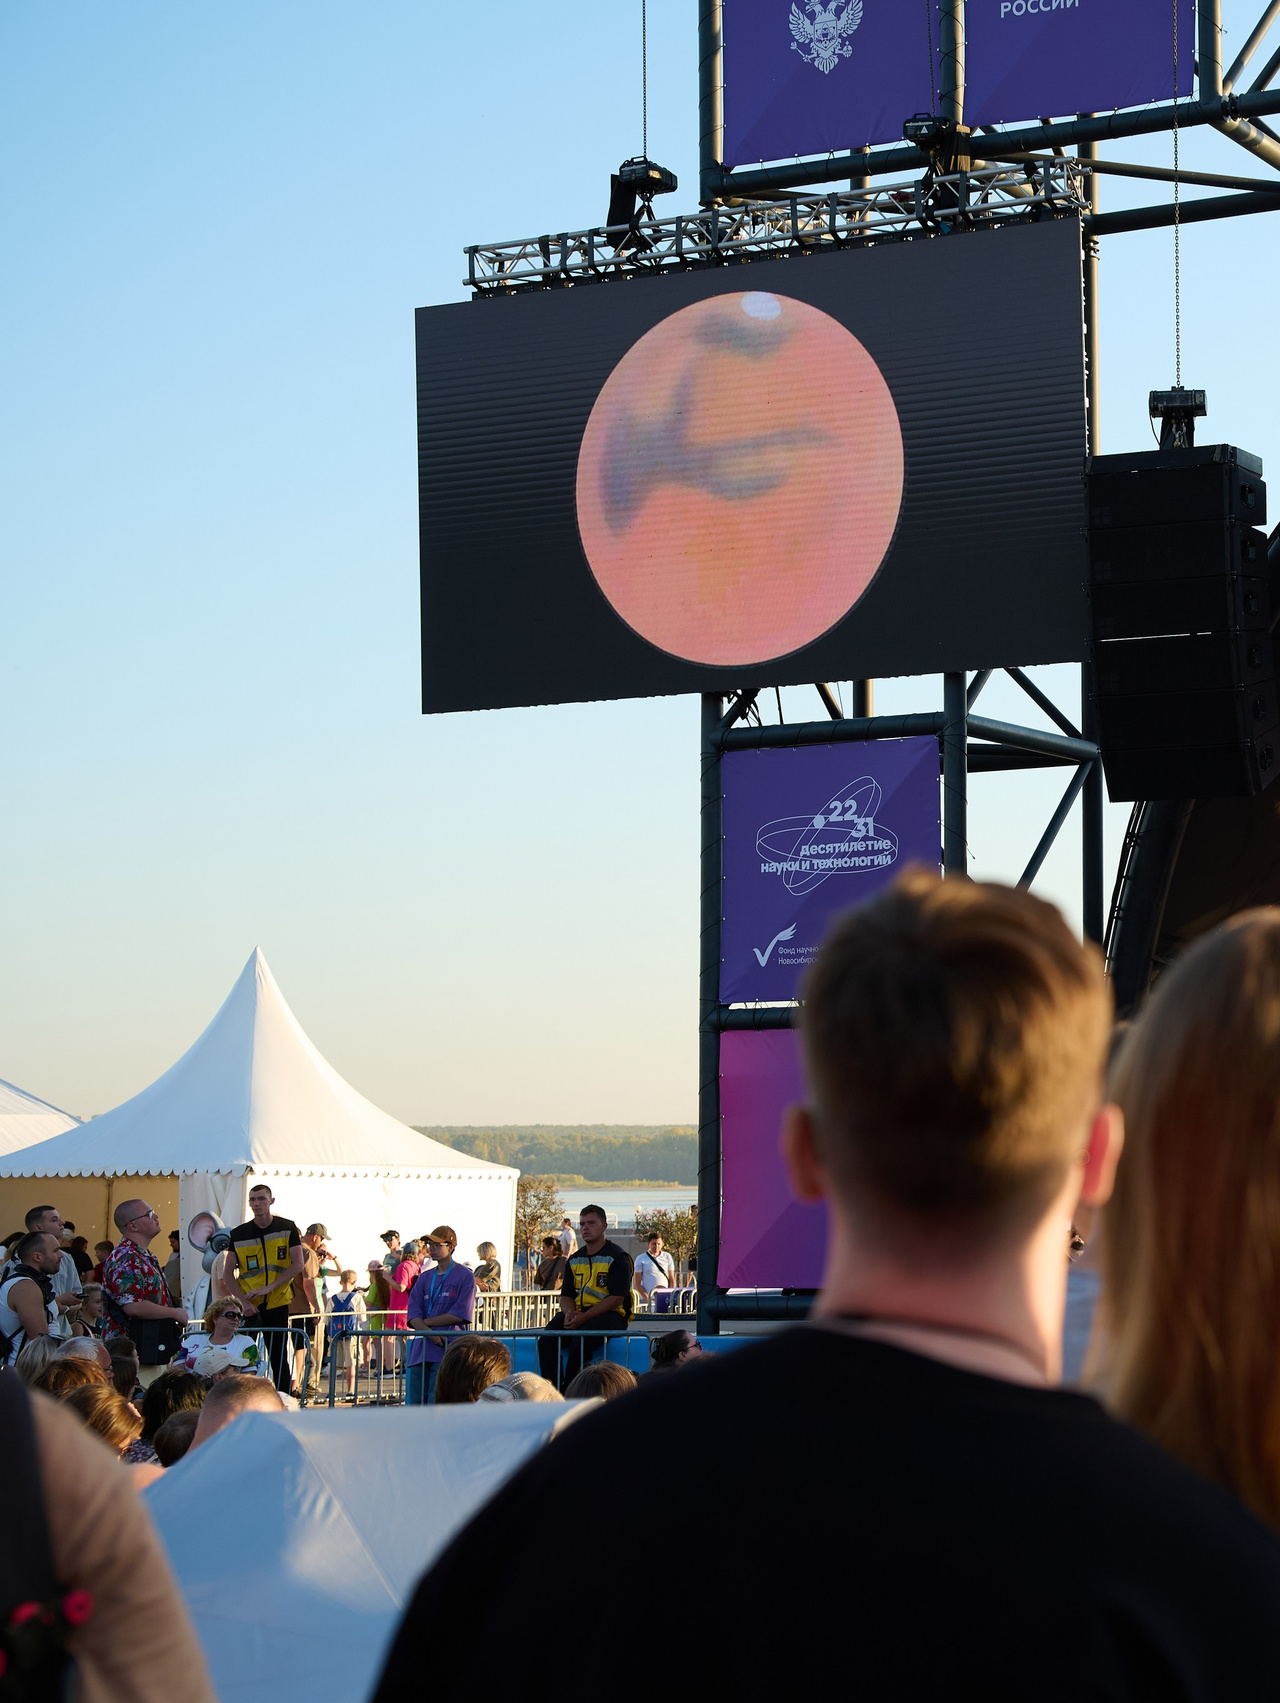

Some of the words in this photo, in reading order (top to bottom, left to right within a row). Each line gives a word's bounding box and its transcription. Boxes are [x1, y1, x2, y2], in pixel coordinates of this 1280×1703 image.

[829, 799, 858, 822] 22
[851, 817, 875, 838] 31
[800, 839, 892, 857] десятилетие
[760, 861, 800, 875] науки
[801, 860, 810, 869] и
[812, 851, 892, 870] технологий
[778, 946, 796, 955] Фонд
[778, 956, 820, 965] Новосибирс
